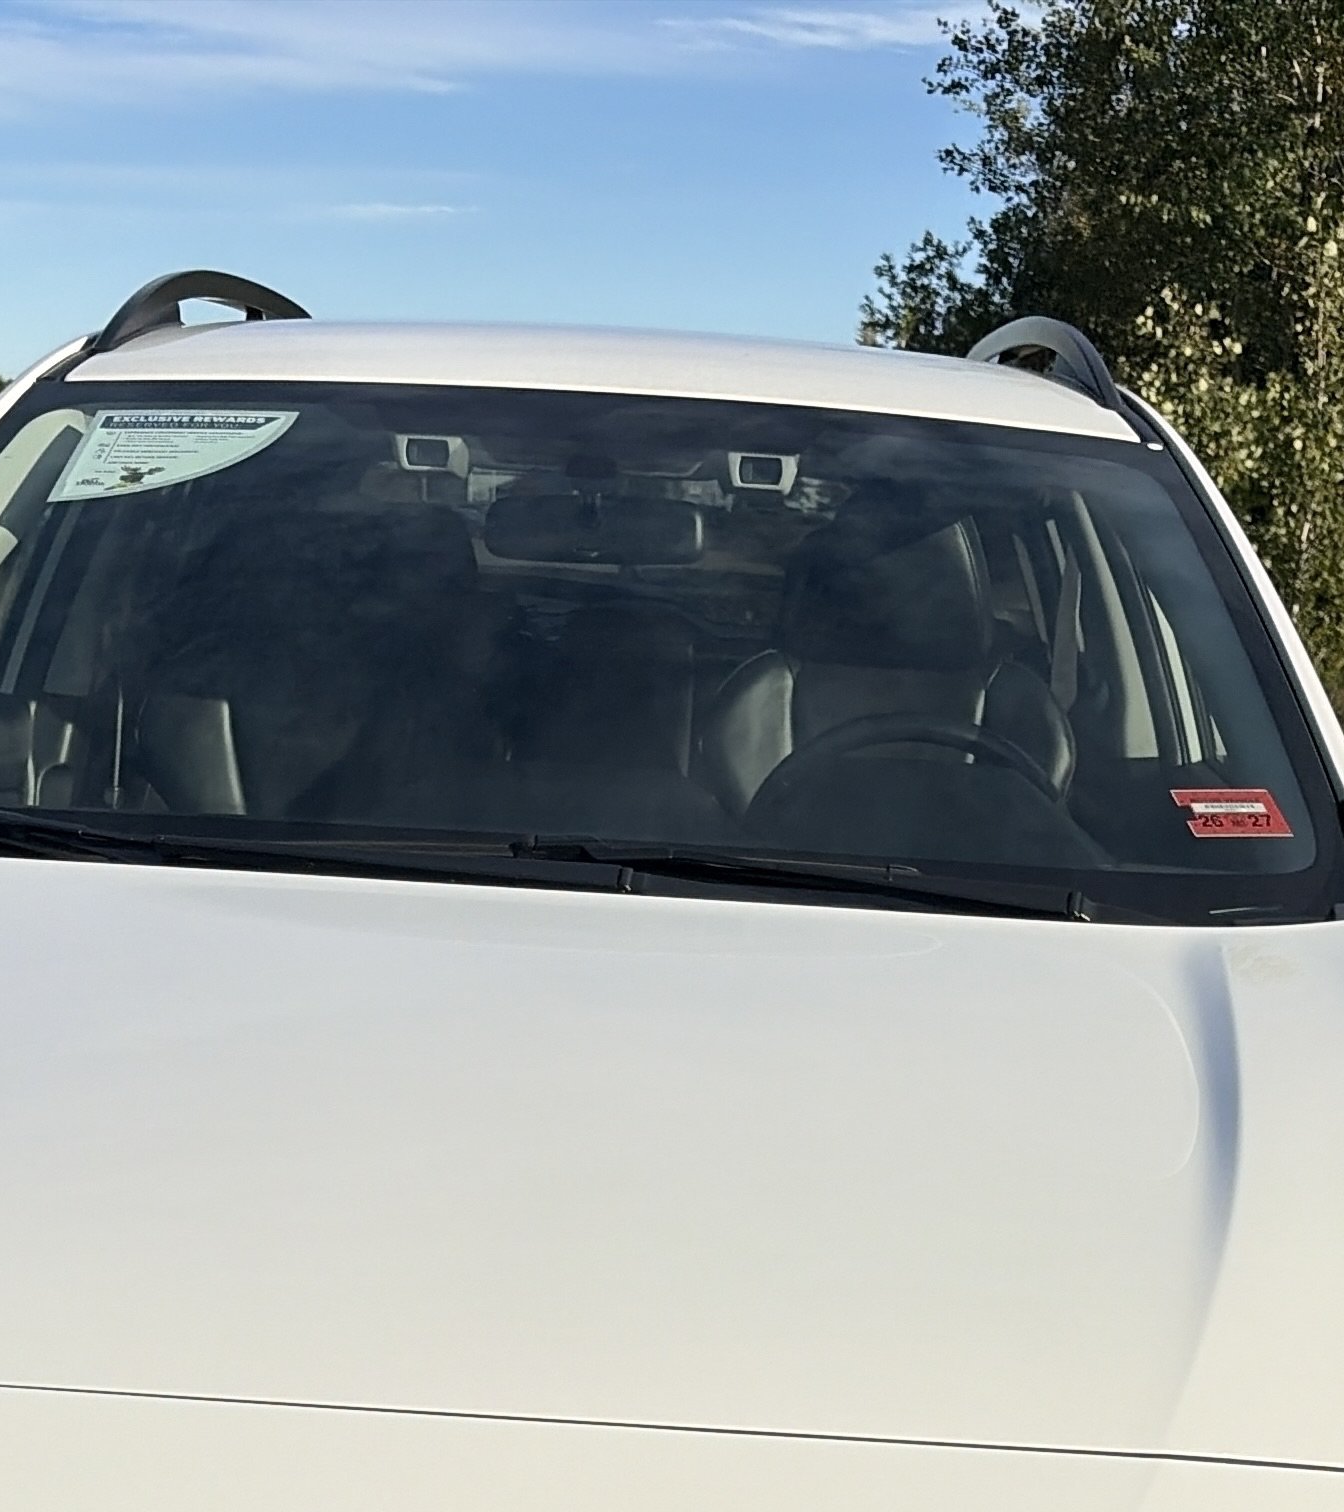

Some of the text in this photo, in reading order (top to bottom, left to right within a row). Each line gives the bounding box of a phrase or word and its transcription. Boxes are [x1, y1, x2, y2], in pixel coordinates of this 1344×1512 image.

[112, 415, 266, 424] EXCLUSIVE REWARDS
[1199, 814, 1224, 827] 26
[1248, 814, 1271, 827] 27
